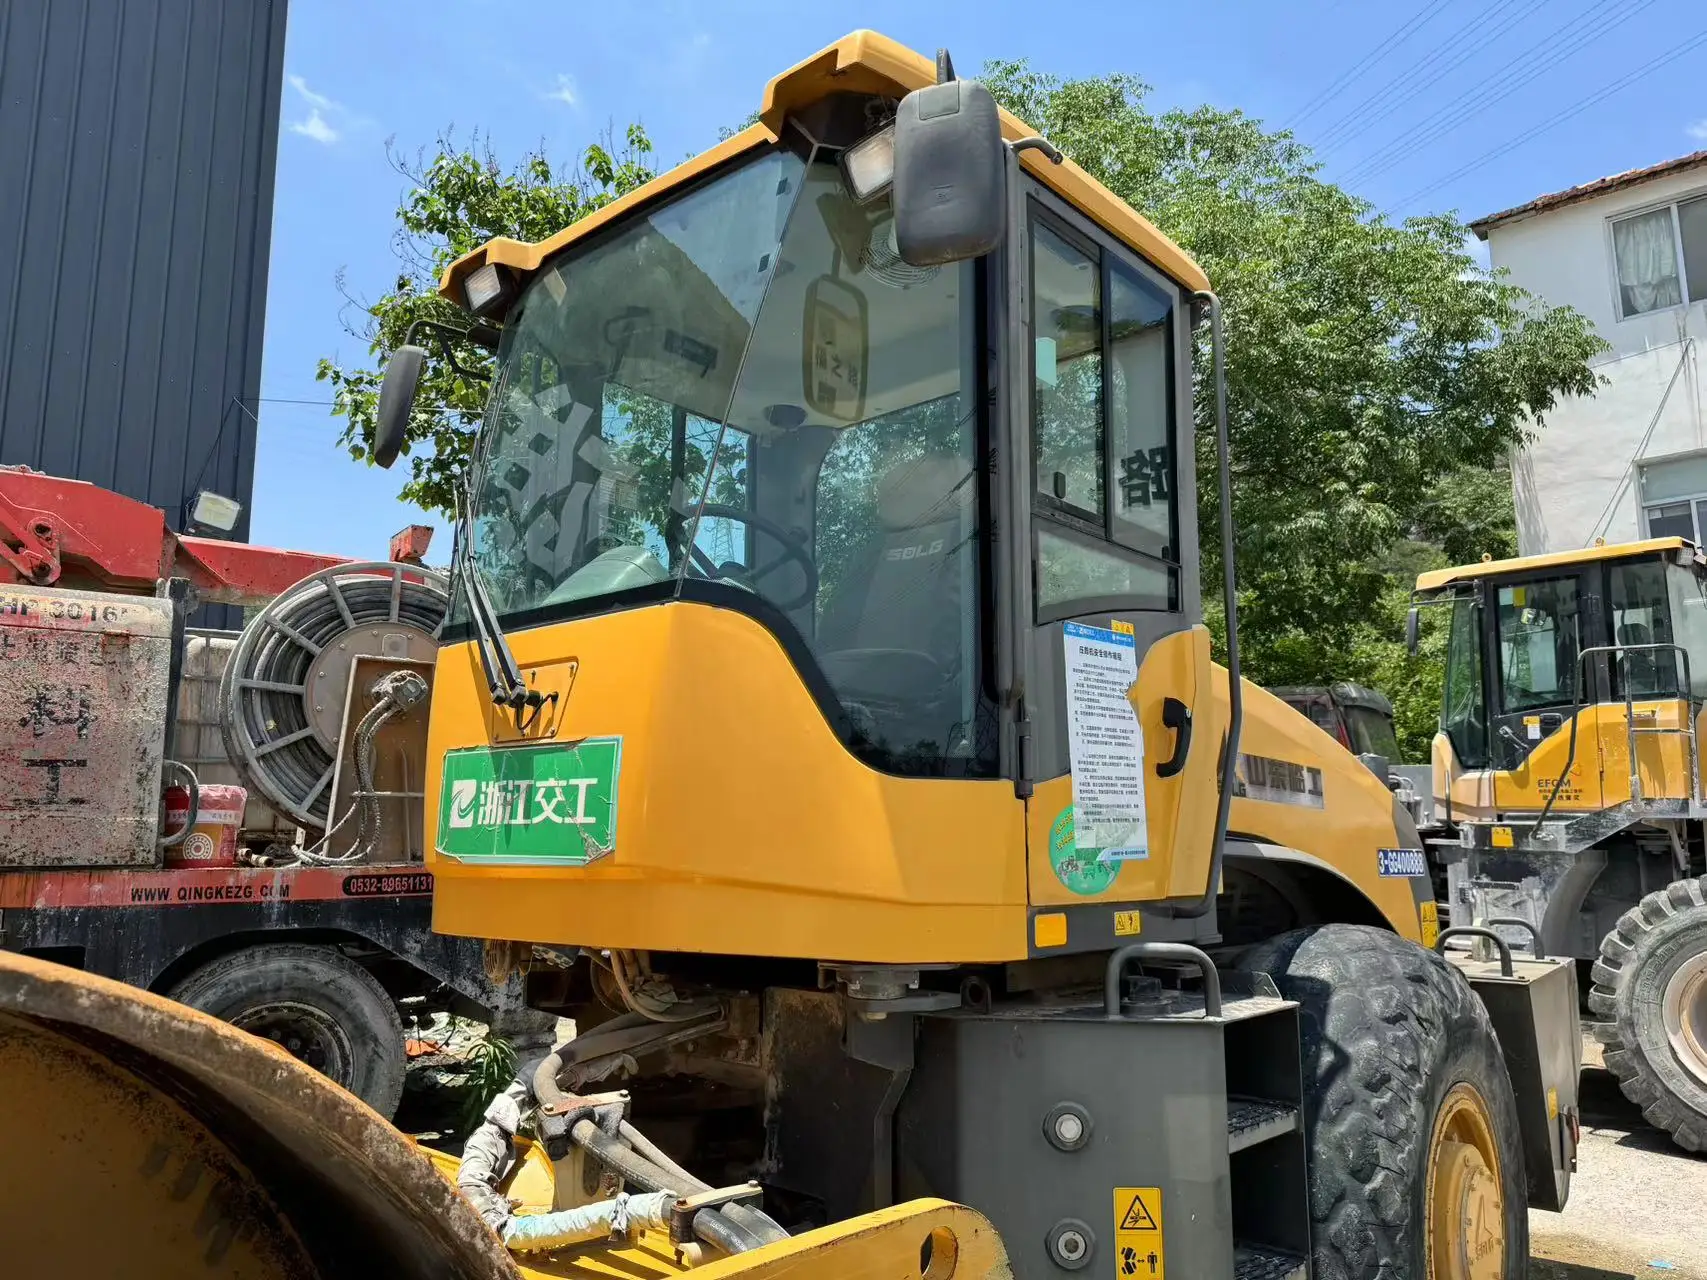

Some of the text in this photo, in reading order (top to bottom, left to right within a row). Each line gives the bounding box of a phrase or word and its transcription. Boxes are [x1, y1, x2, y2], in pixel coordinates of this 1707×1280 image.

[478, 777, 598, 825] 浙江交工
[350, 876, 433, 893] 0532-89651131
